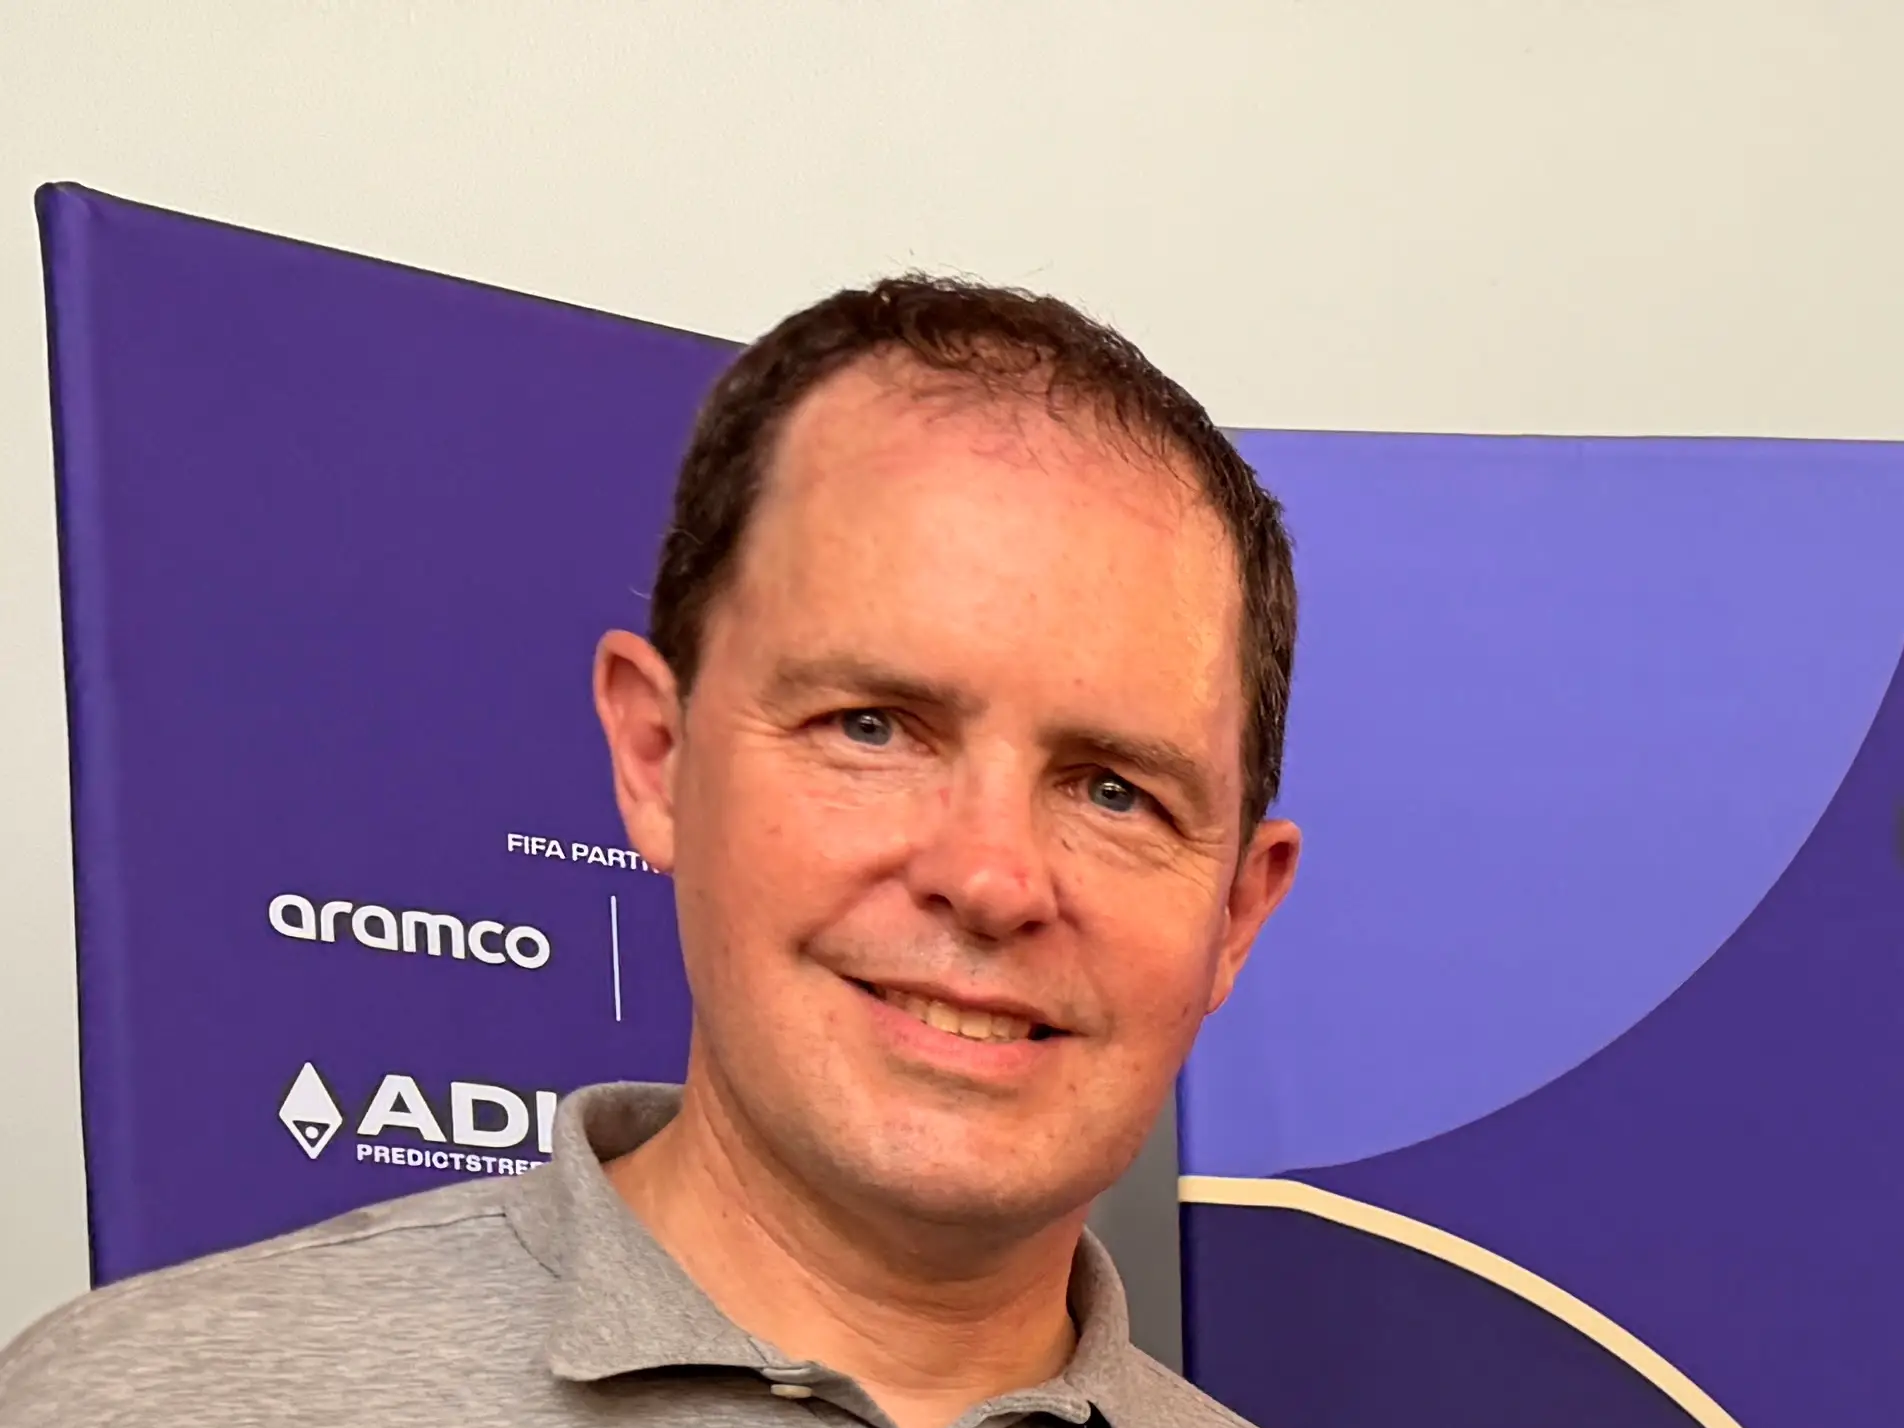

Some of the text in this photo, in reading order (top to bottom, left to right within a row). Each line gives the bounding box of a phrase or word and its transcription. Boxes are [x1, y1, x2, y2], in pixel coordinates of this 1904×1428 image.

[507, 833, 566, 861] FIFA
[268, 893, 551, 970] aramco
[356, 1074, 556, 1153] ADI
[357, 1144, 553, 1176] PREDICTSTRE
